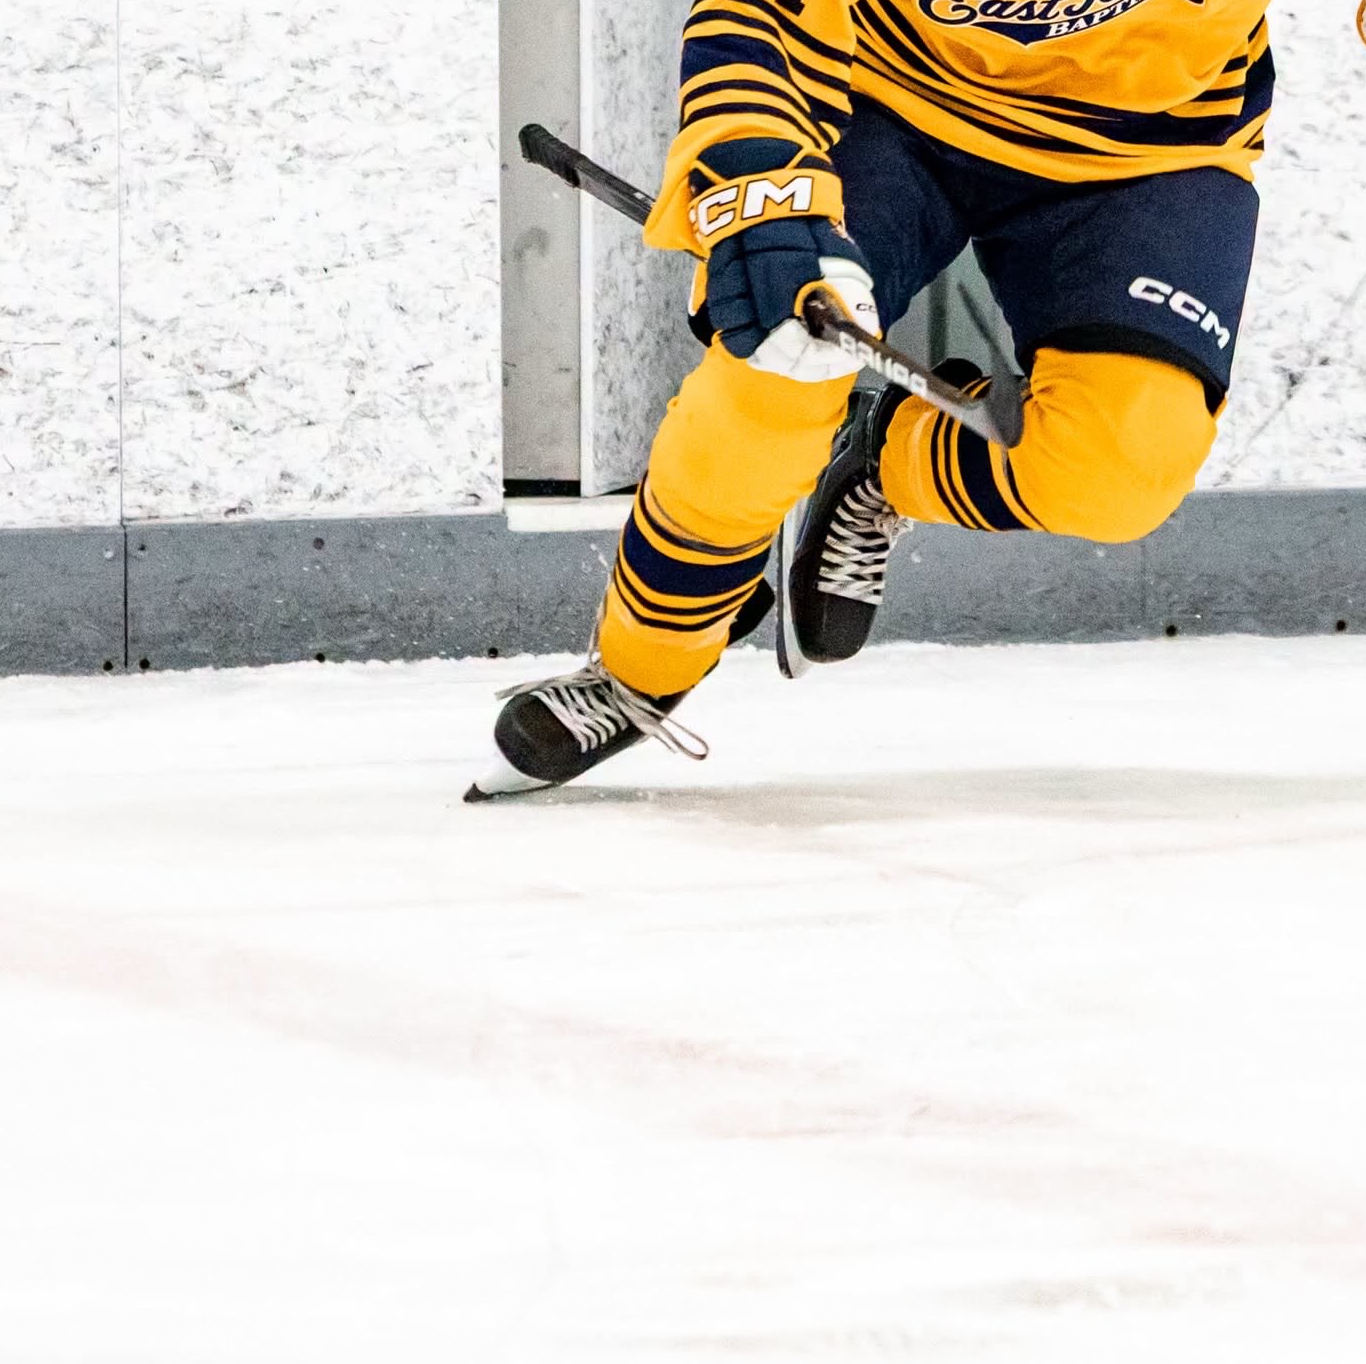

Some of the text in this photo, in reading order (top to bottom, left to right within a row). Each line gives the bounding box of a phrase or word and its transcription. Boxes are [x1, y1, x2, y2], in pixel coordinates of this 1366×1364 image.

[689, 176, 815, 237] CM
[856, 302, 877, 313] CC
[1128, 276, 1231, 350] CCM
